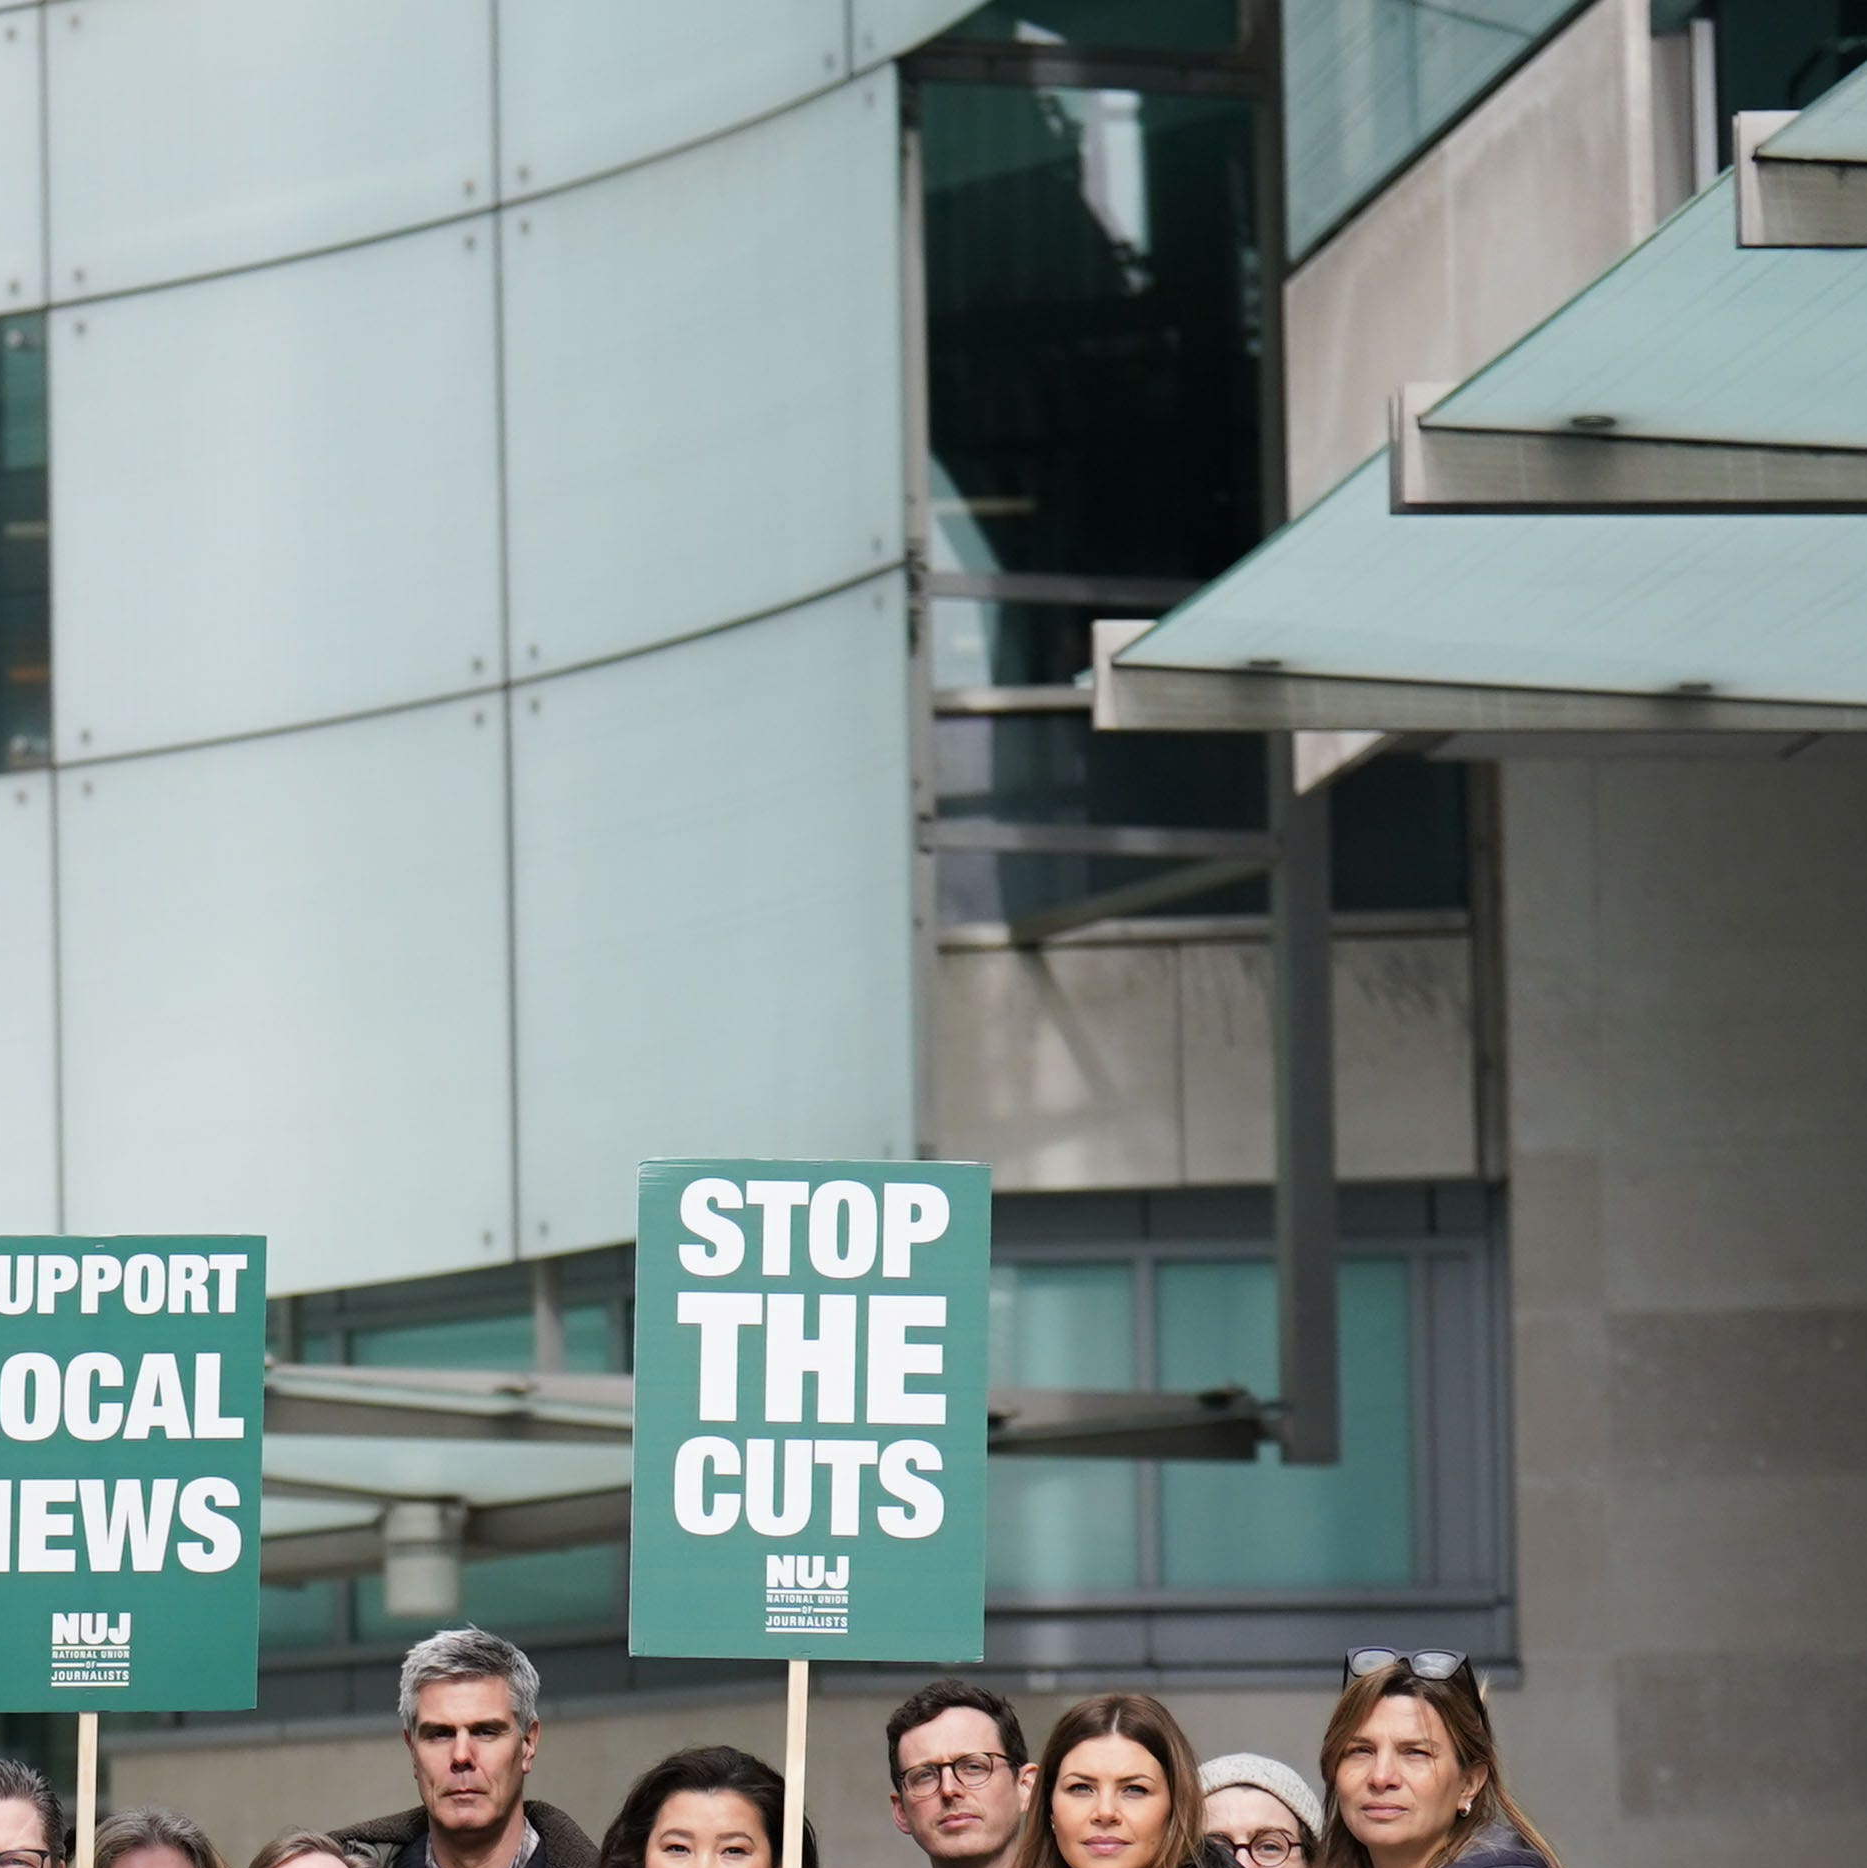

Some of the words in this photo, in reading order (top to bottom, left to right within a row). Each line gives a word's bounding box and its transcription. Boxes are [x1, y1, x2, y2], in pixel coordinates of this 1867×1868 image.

[679, 1178, 949, 1278] STOP
[678, 1292, 946, 1424] THE
[674, 1436, 944, 1538] CUTS
[767, 1555, 849, 1588] NUJ
[766, 1594, 814, 1603] NATIONAL
[817, 1595, 848, 1604] UNION
[53, 1613, 130, 1644] NUJ
[766, 1616, 847, 1627] JOURNALISTS
[52, 1650, 97, 1659] NATIONAL
[100, 1650, 130, 1659] UNION
[51, 1670, 129, 1681] JOURNALISTS
